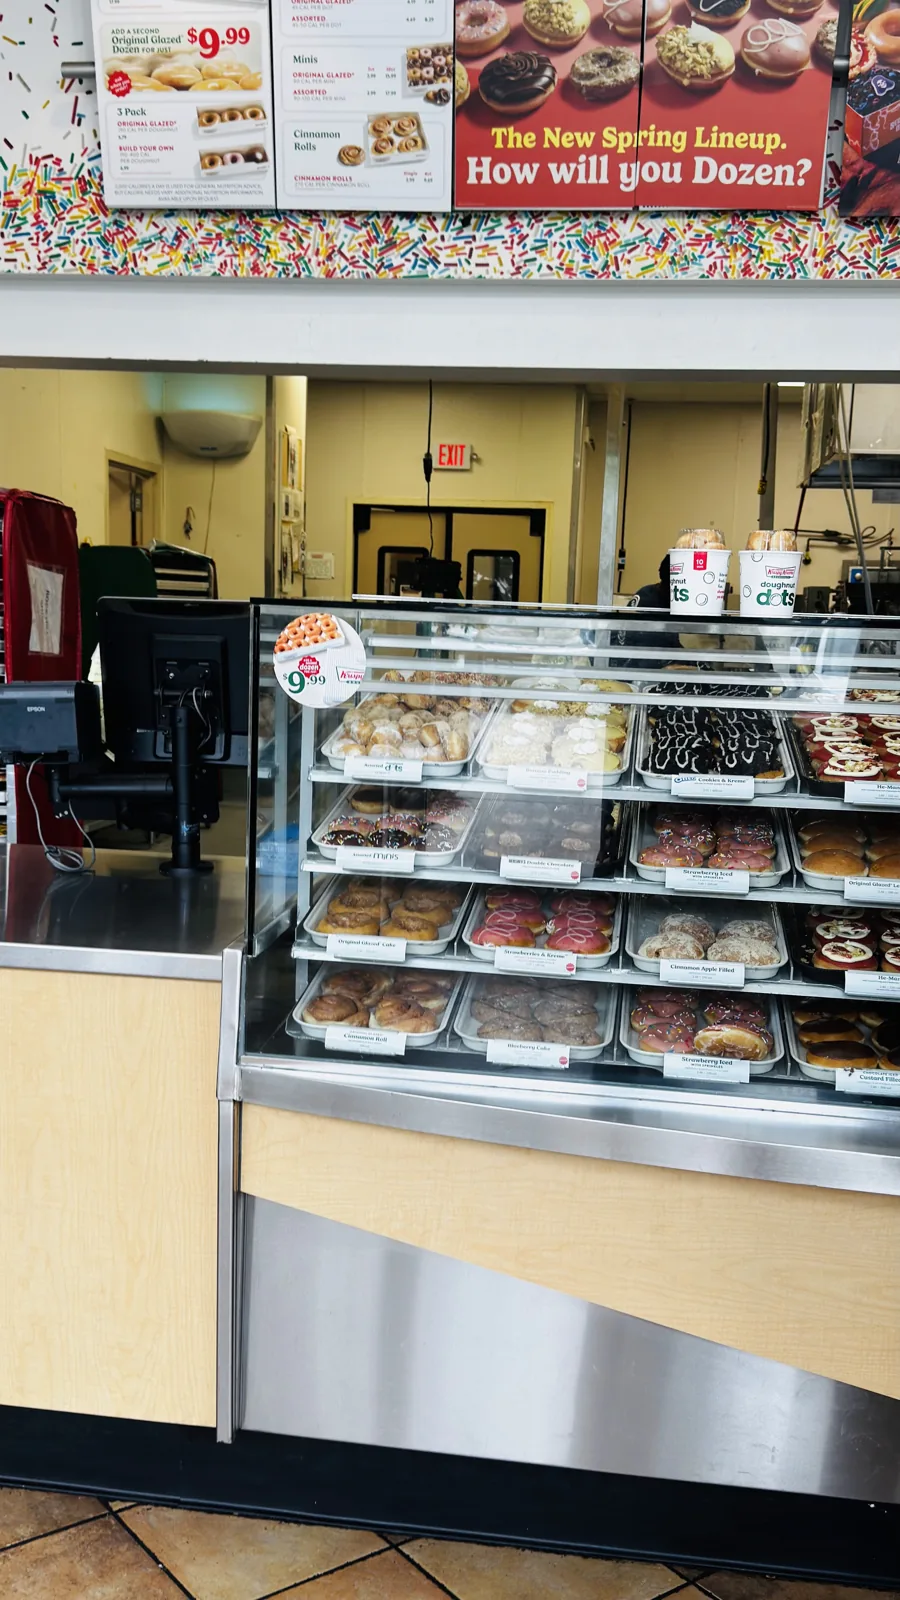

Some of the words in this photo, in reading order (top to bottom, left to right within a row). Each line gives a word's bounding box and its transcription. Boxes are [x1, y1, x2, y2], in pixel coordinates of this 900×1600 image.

[111, 35, 149, 46] Original
[112, 46, 140, 54] Dozen
[293, 55, 318, 63] Minis
[117, 108, 122, 116] 3
[125, 107, 147, 116] Pack
[293, 129, 341, 139] Cinnamon
[491, 126, 536, 148] The
[543, 127, 596, 148] New
[602, 126, 687, 153] Spring
[694, 126, 787, 155] Lineup.
[294, 142, 316, 151] Rolls
[466, 156, 540, 185] How
[547, 154, 609, 184] will
[619, 161, 682, 192] you
[692, 156, 812, 187] Dozen?
[438, 444, 466, 466] EXIT
[760, 581, 795, 590] doughnut
[299, 664, 318, 672] dozen
[681, 1057, 718, 1065] Strawberry
